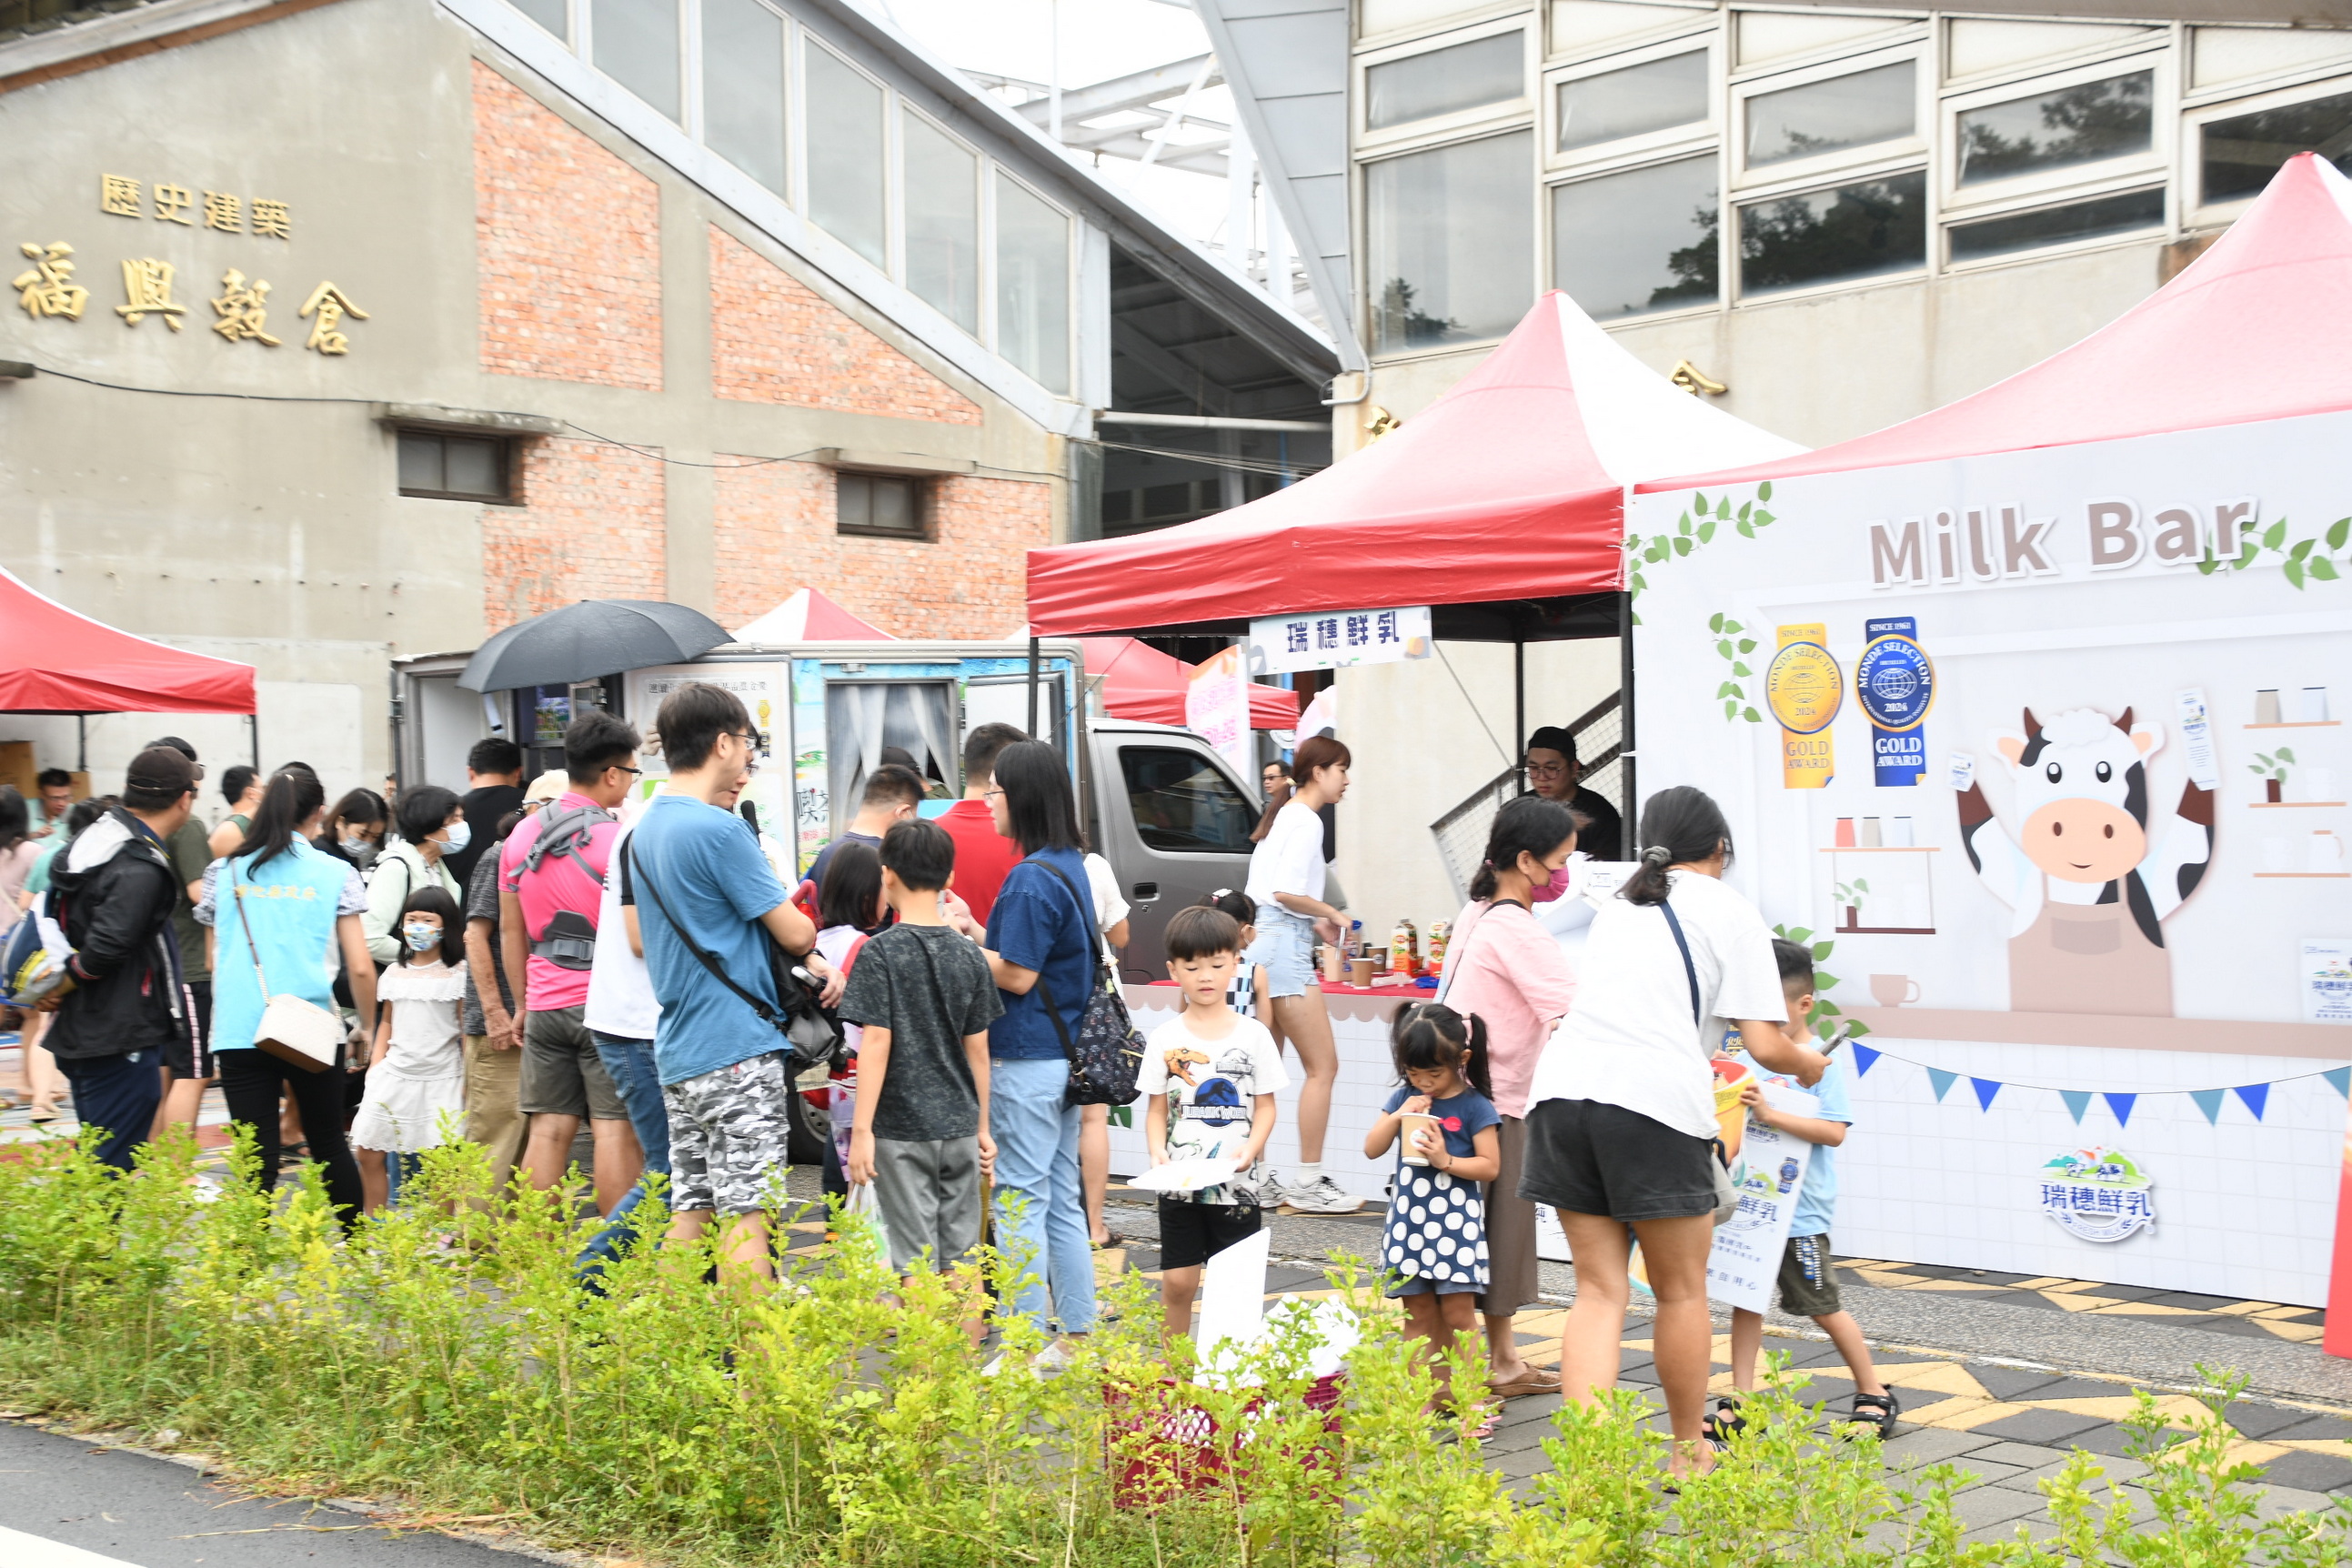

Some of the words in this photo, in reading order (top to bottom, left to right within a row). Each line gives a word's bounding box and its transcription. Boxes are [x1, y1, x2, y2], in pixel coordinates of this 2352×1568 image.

[101, 173, 293, 240] 歷史建築
[12, 240, 370, 356] 福興穀倉
[1867, 505, 2055, 587] Milk
[2086, 499, 2256, 570] Bar
[1285, 610, 1400, 653] 瑞穗鮮乳
[1869, 623, 1895, 632] SINCE
[1770, 651, 1794, 692] MONDE
[1794, 648, 1838, 690] SELECTION
[1858, 647, 1885, 689] MONDE
[1882, 641, 1931, 686] SELECTION
[1785, 740, 1830, 757] GOLD
[1785, 758, 1831, 769] AWARD
[1875, 737, 1923, 754] GOLD
[1875, 755, 1924, 768] AWARD
[2040, 1184, 2151, 1217] 瑞穗鮮乳
